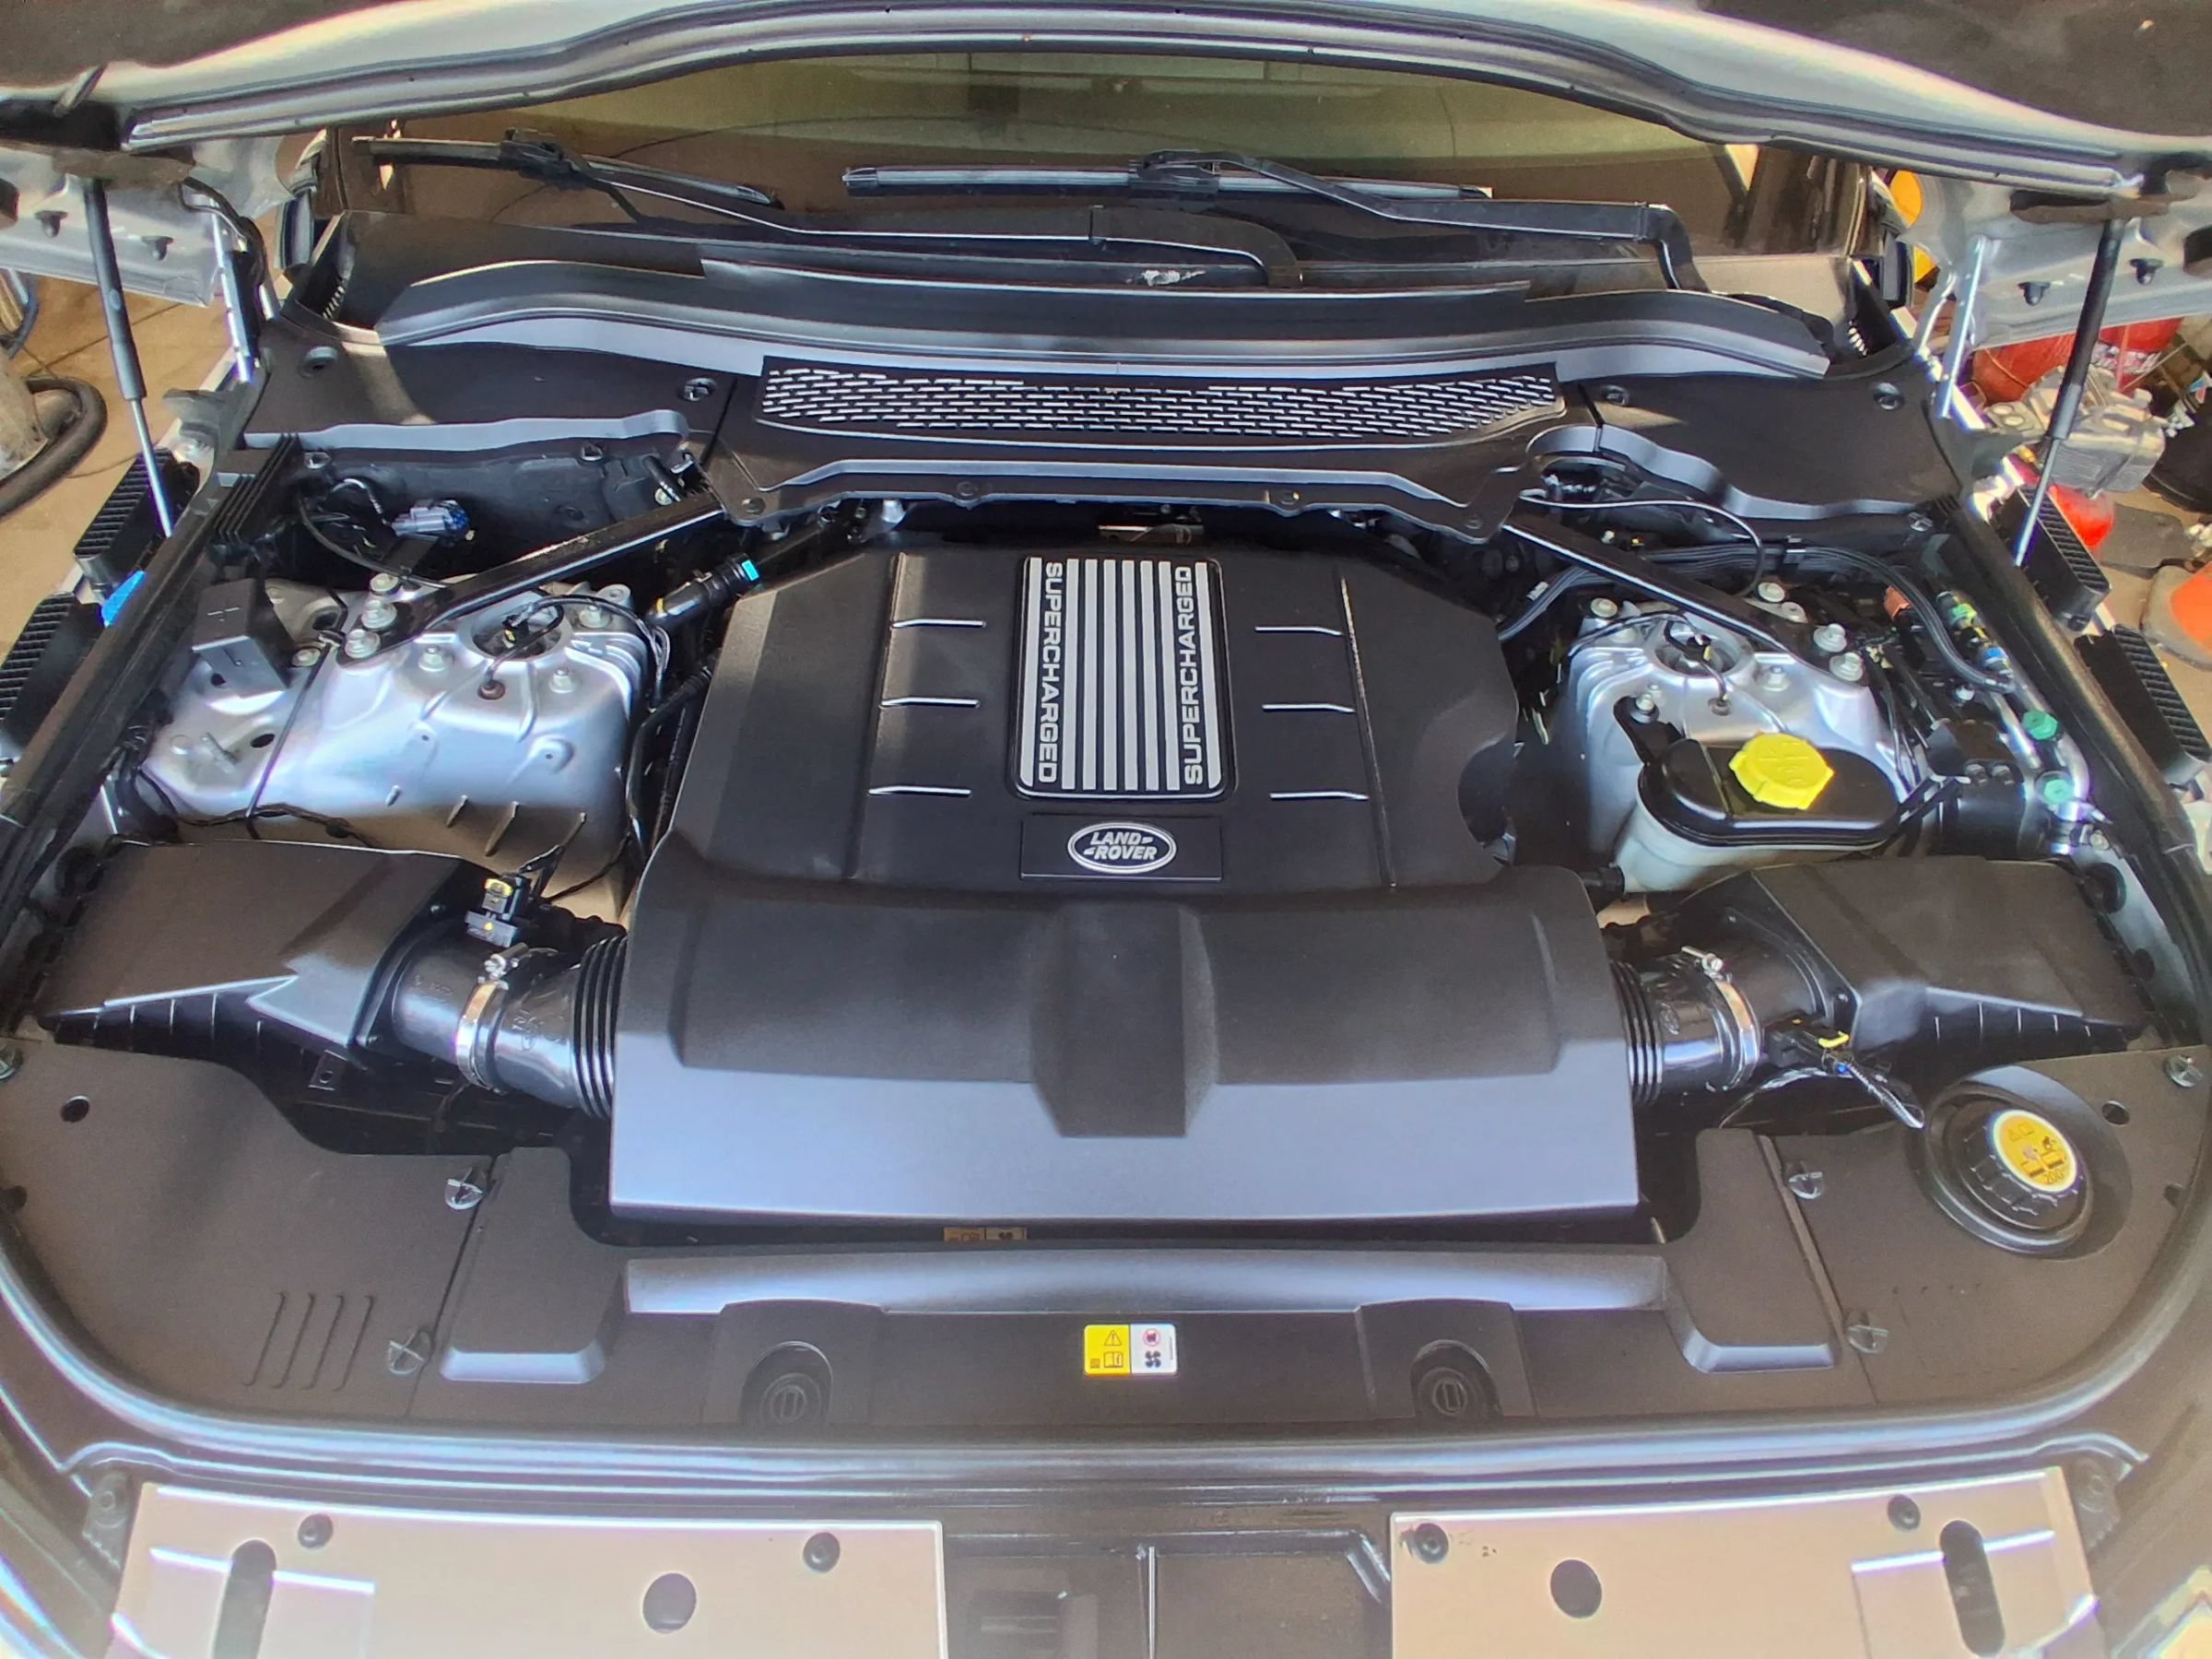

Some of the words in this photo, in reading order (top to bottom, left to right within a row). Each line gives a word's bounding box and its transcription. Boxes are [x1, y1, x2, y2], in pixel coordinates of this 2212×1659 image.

[1038, 561, 1064, 783] SUPERCHARGED
[1175, 566, 1204, 784] SUPERCHARGED
[1089, 831, 1142, 845] LAND
[1093, 845, 1158, 860] ROVER
